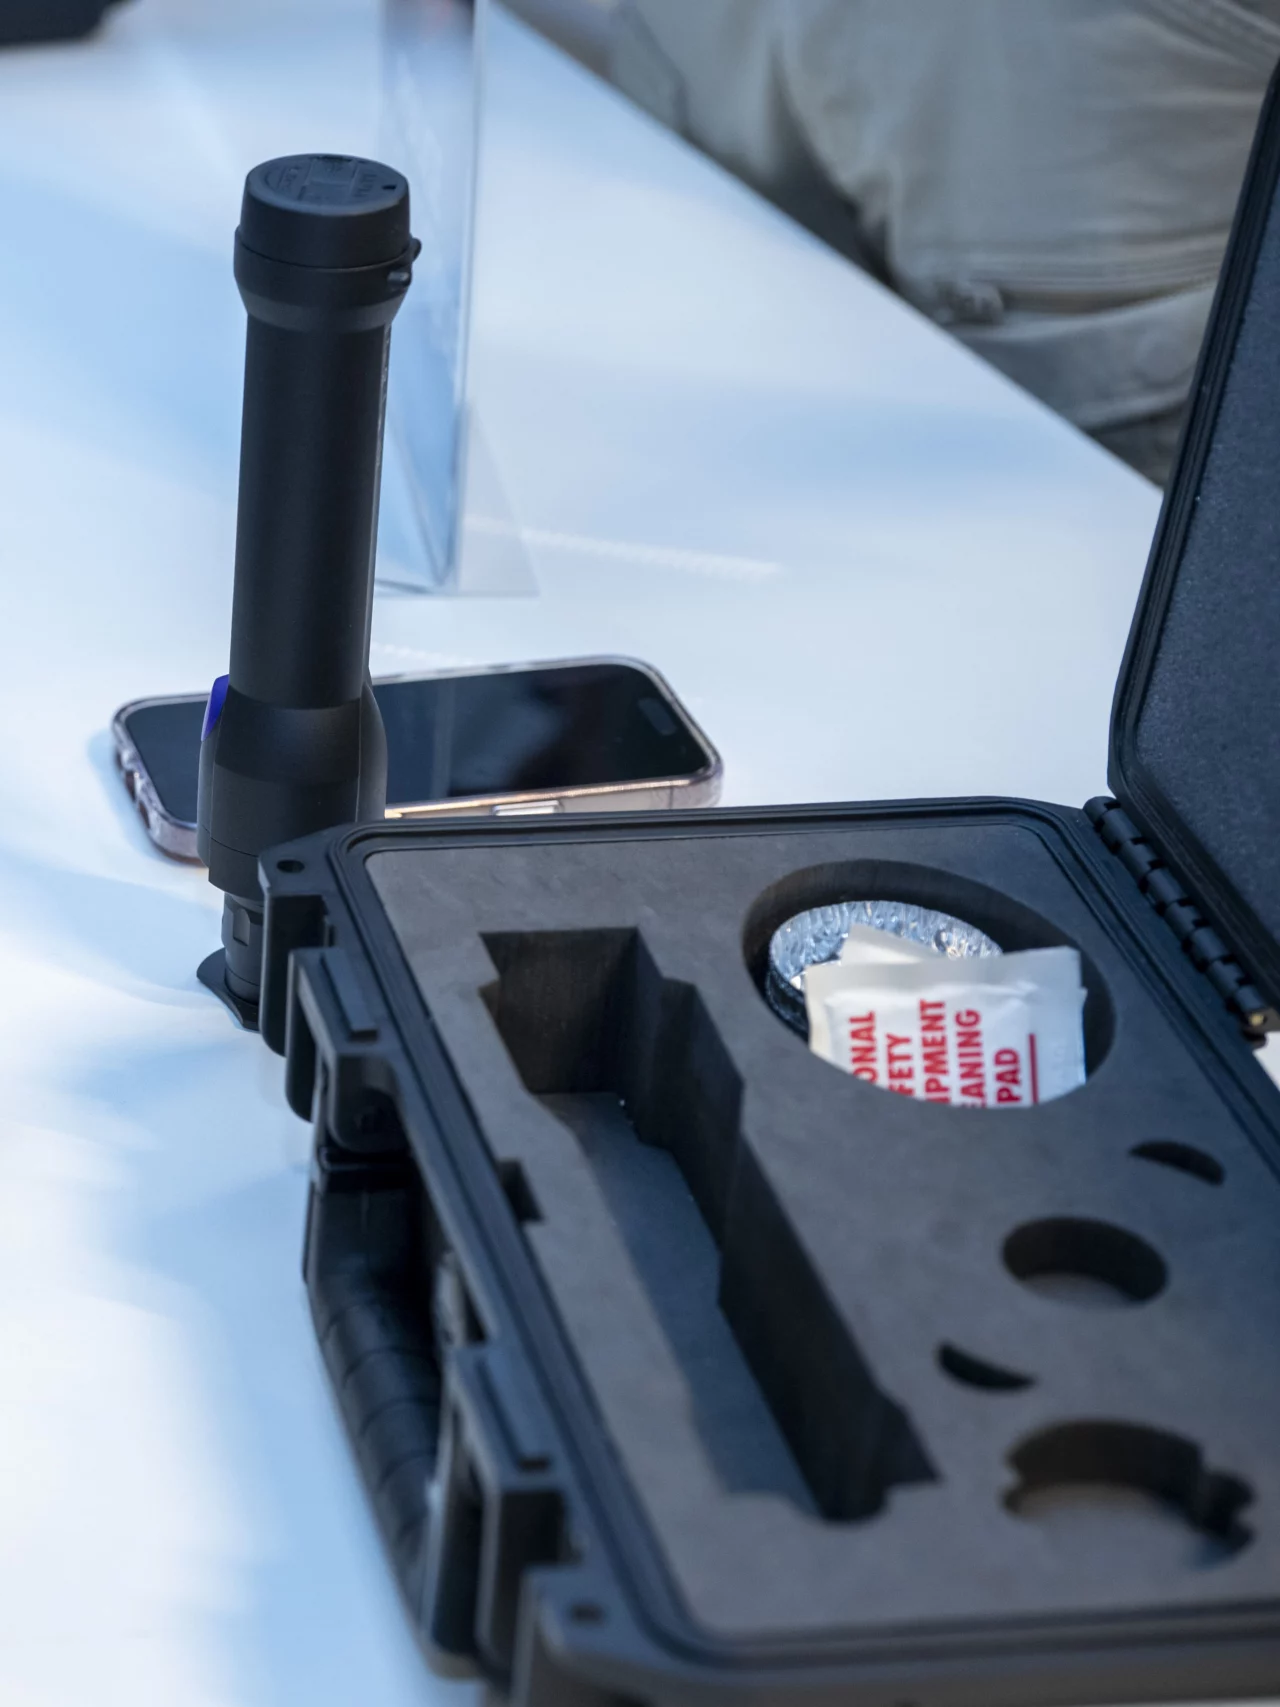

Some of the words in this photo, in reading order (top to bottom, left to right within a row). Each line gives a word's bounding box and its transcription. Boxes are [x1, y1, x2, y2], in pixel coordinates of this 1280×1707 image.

[849, 1010, 878, 1084] ONAL
[885, 1033, 915, 1096] FETY
[919, 998, 951, 1104] IPMENT
[955, 1009, 987, 1107] ANING
[994, 1048, 1022, 1103] PAD
